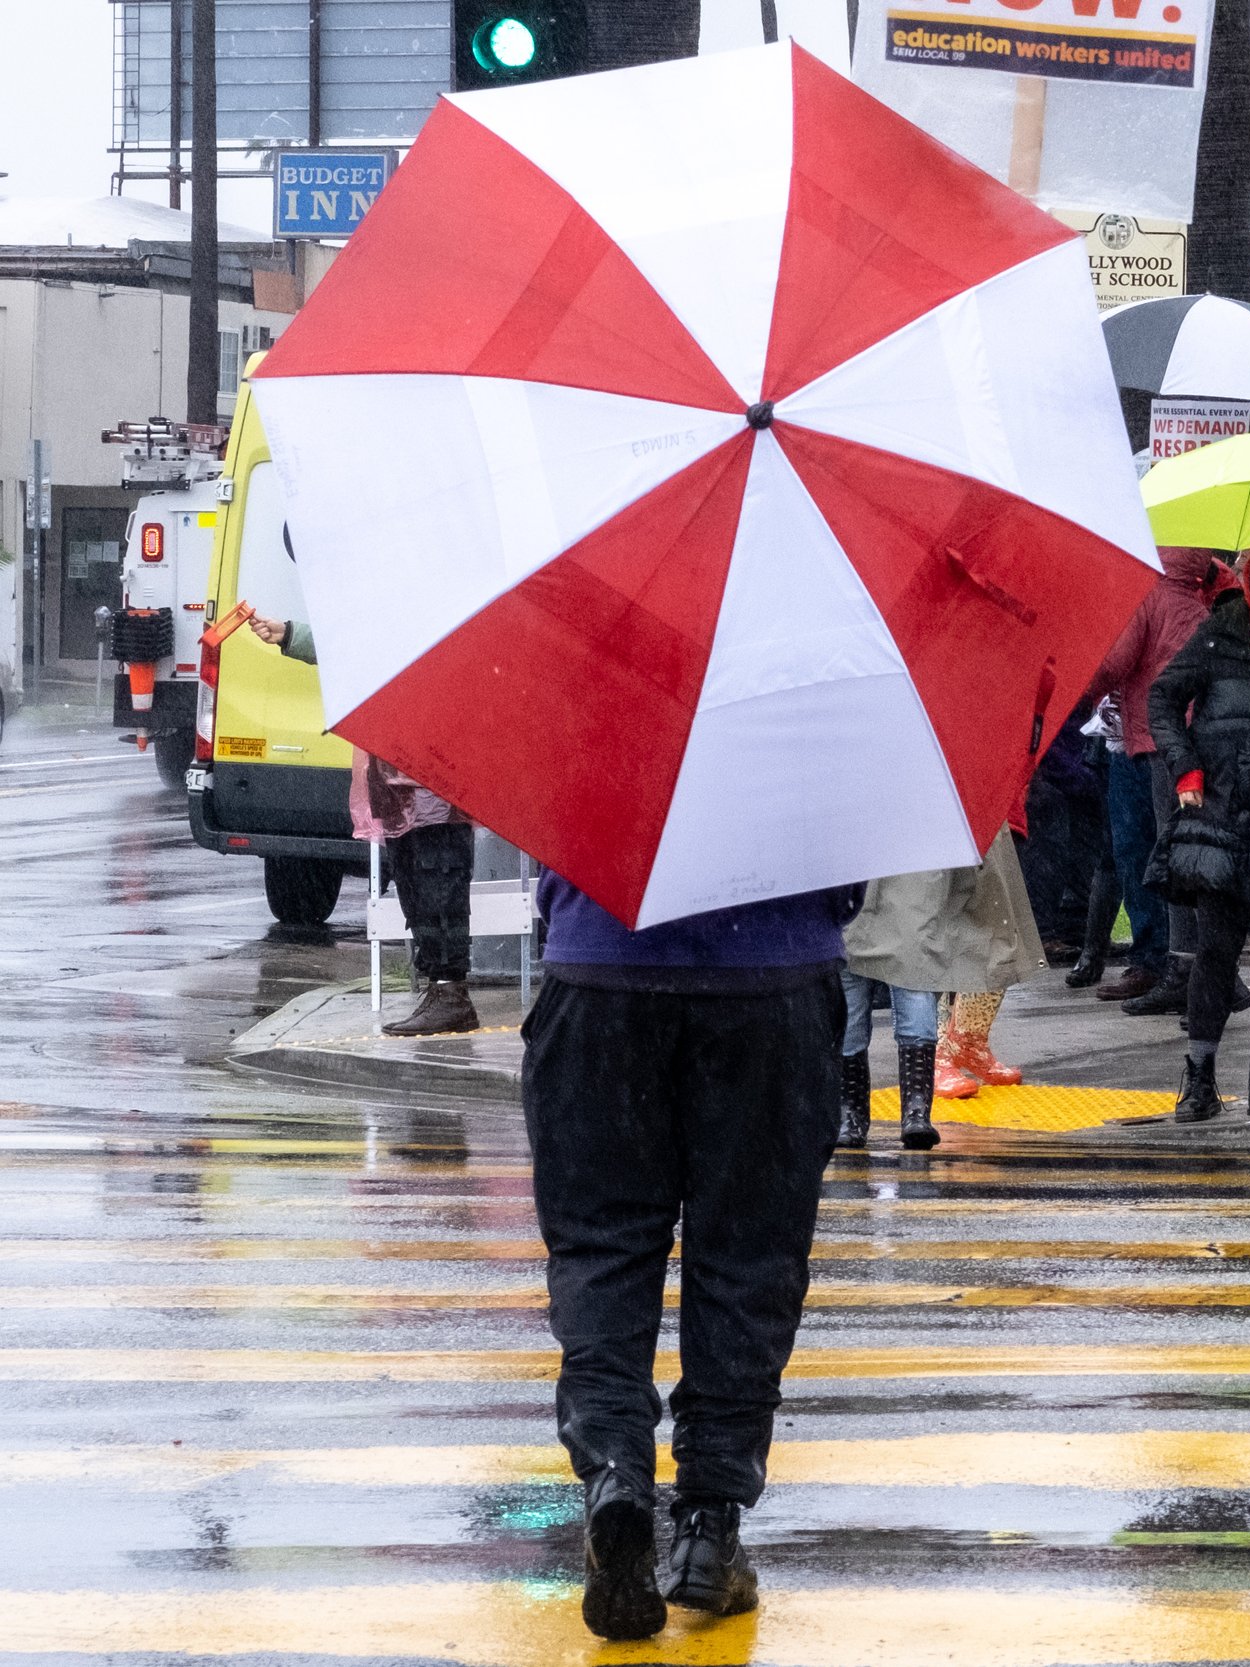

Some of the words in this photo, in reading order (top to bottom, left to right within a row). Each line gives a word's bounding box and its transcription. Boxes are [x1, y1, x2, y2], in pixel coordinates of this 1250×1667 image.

[893, 28, 1011, 55] education
[1016, 41, 1110, 65] workers
[1114, 47, 1191, 71] united
[893, 47, 916, 57] SEIU
[918, 50, 949, 60] LOCAL
[282, 167, 382, 185] BUDGET
[285, 191, 378, 221] INN
[1088, 255, 1172, 270] LLYWOOD
[1109, 273, 1178, 287] SCHOOL
[1171, 408, 1206, 416] ESSENTIAL
[1234, 409, 1249, 417] DAY
[1154, 419, 1173, 433] WE
[1177, 420, 1246, 435] DEMAND
[631, 433, 679, 458] EDWIN
